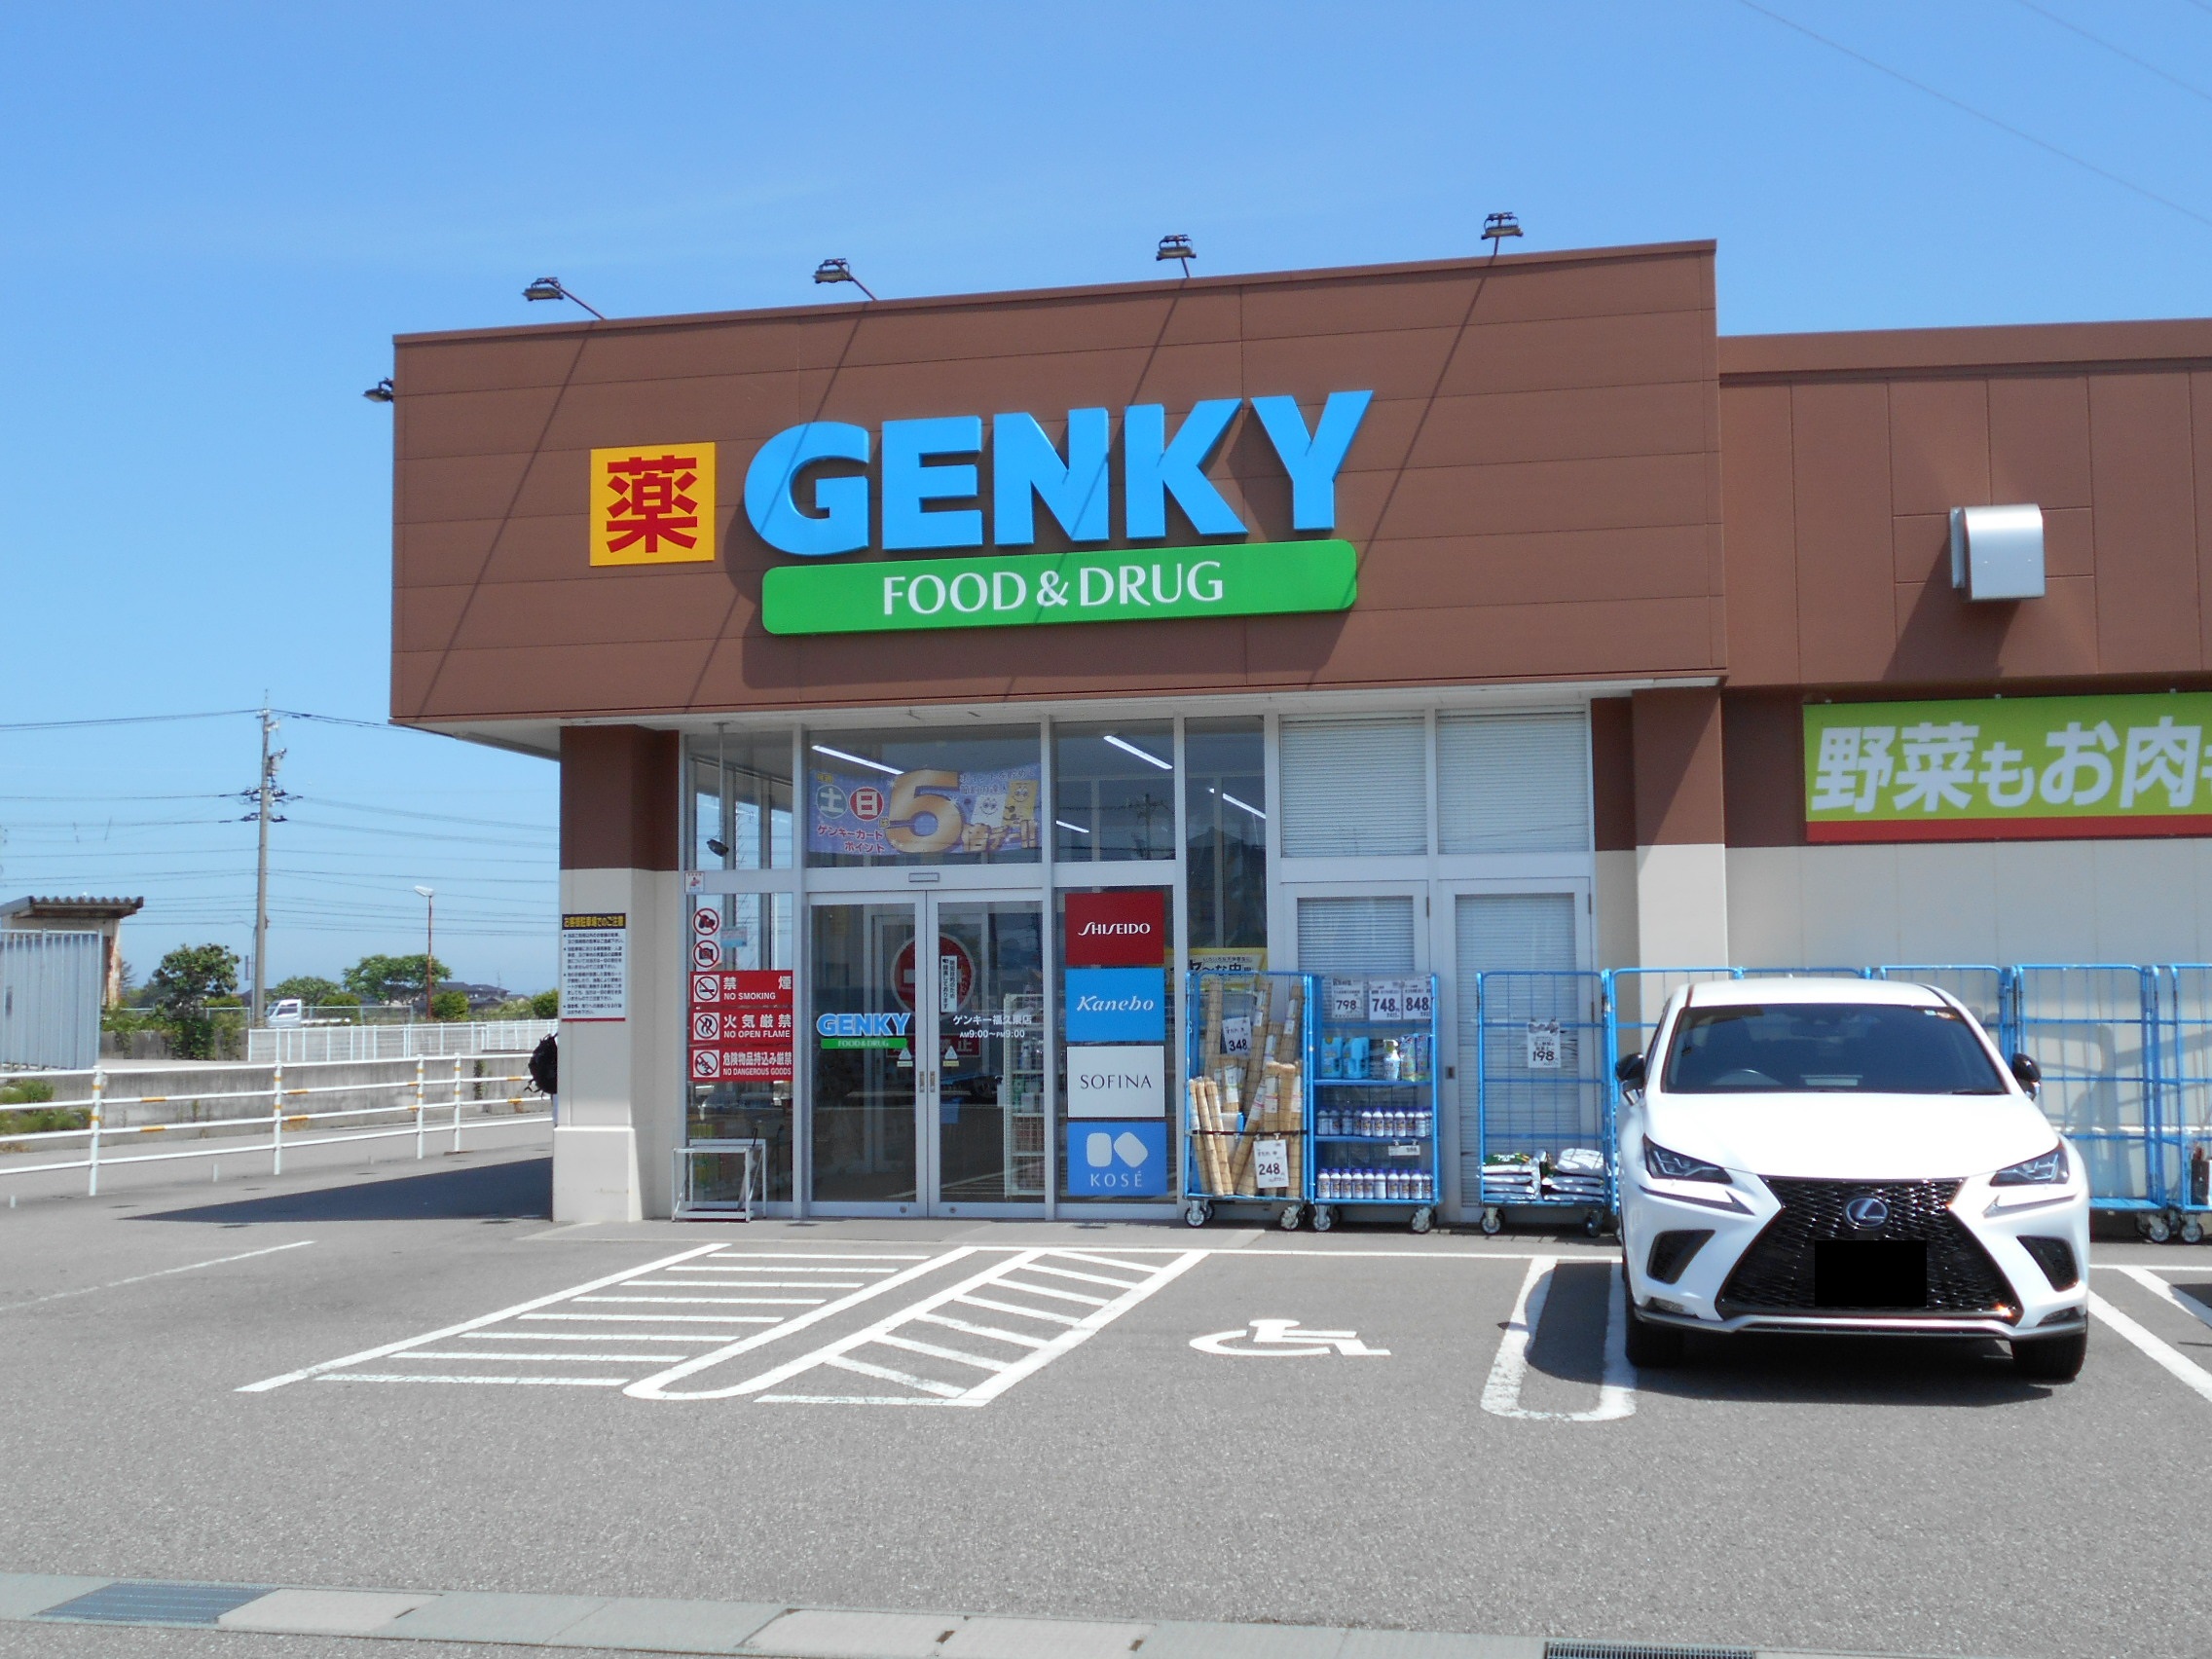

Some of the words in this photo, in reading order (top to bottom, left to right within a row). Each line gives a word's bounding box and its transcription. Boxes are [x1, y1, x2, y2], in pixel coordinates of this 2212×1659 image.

[744, 389, 1375, 556] GENKY
[606, 454, 699, 554] 薬
[1078, 921, 1151, 936] SHISEIDO
[723, 992, 736, 1001] NO
[1076, 995, 1154, 1012] Kanebo
[1336, 999, 1357, 1011] 798
[816, 1014, 911, 1037] GENKY
[1229, 1039, 1248, 1051] 348
[1532, 1051, 1555, 1061] 198
[733, 1067, 770, 1076] DANGEROUS
[770, 1067, 792, 1076] GOODS
[1080, 1074, 1152, 1089] SOFINA
[1258, 1162, 1280, 1175] 248
[1090, 1170, 1143, 1187] KOSÉ
